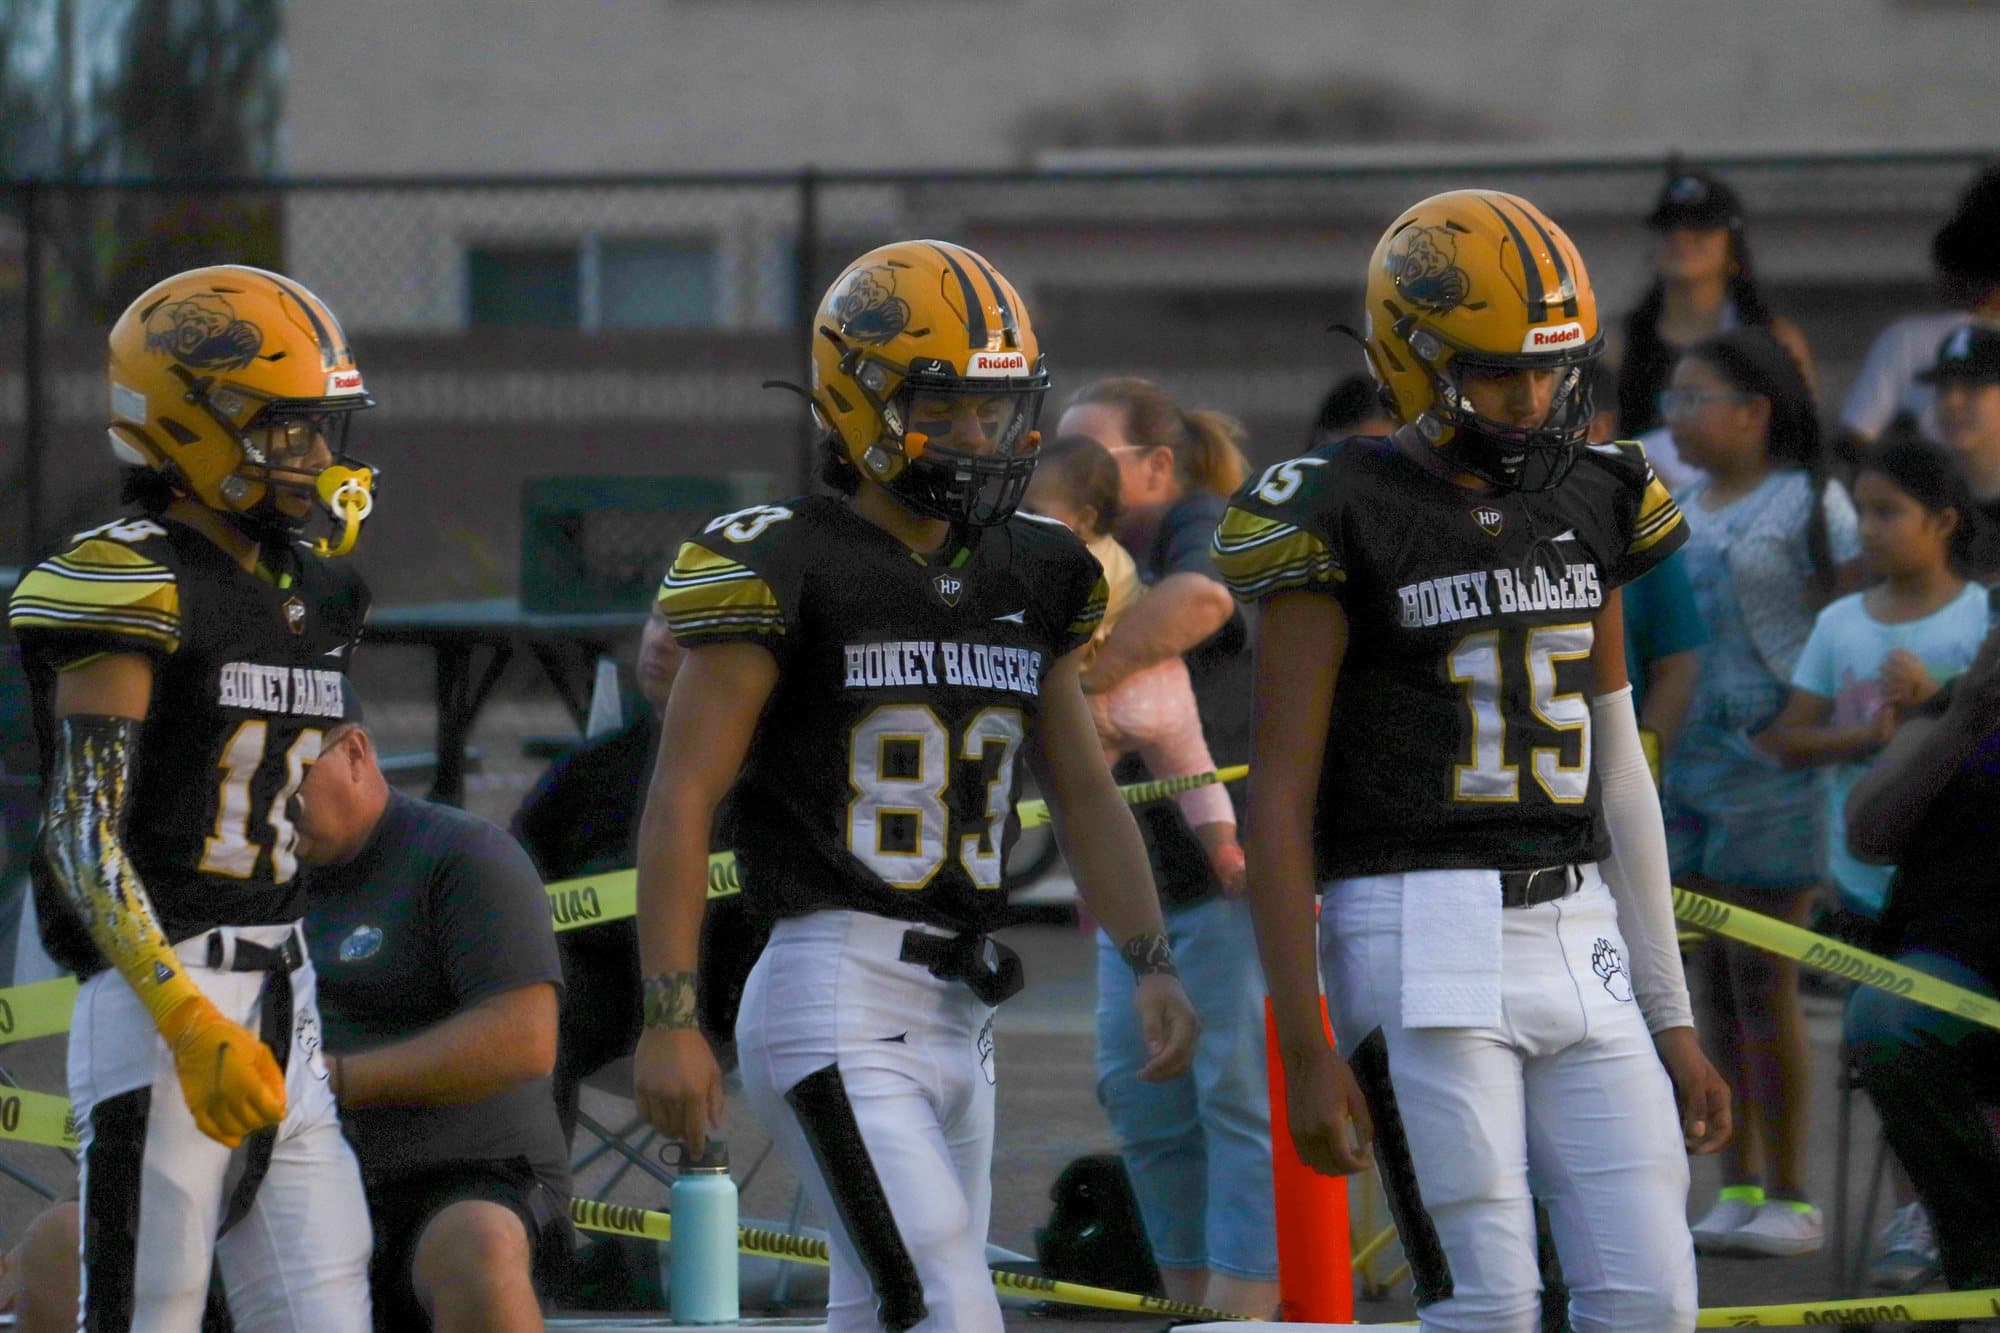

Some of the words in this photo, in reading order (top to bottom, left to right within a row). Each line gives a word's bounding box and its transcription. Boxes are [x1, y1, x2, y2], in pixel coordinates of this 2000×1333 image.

[1534, 328, 1579, 345] Riddell
[978, 356, 1023, 368] Riddell
[1478, 511, 1500, 525] HP
[940, 579, 961, 594] HP
[1397, 571, 1493, 628] HONEY
[219, 662, 290, 714] HONEY
[844, 641, 938, 688] HONEY
[940, 642, 1042, 697] BADGERS
[1448, 622, 1595, 805] 15
[847, 703, 1025, 891] 83
[571, 1198, 645, 1234] UTION
